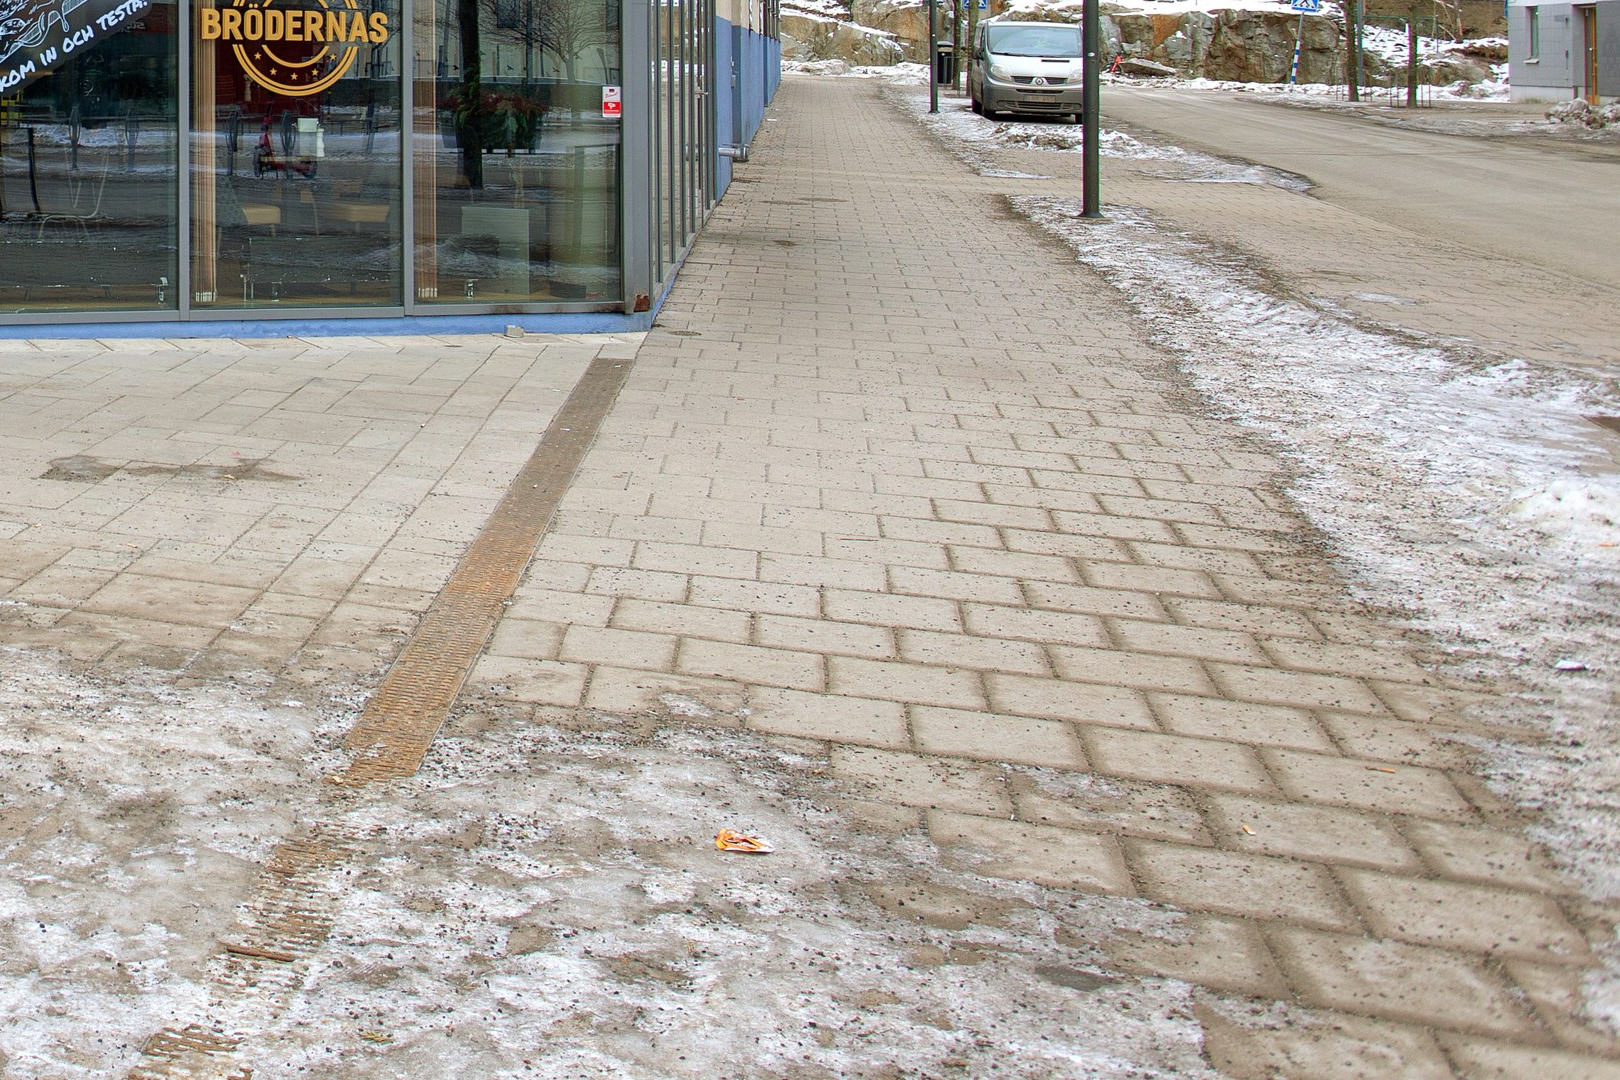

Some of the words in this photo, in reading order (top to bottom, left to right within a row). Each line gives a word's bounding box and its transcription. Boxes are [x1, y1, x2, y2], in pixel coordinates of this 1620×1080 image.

[201, 3, 389, 43] BRÖDERNAS
[40, 46, 58, 64] IN
[62, 26, 95, 53] OCH
